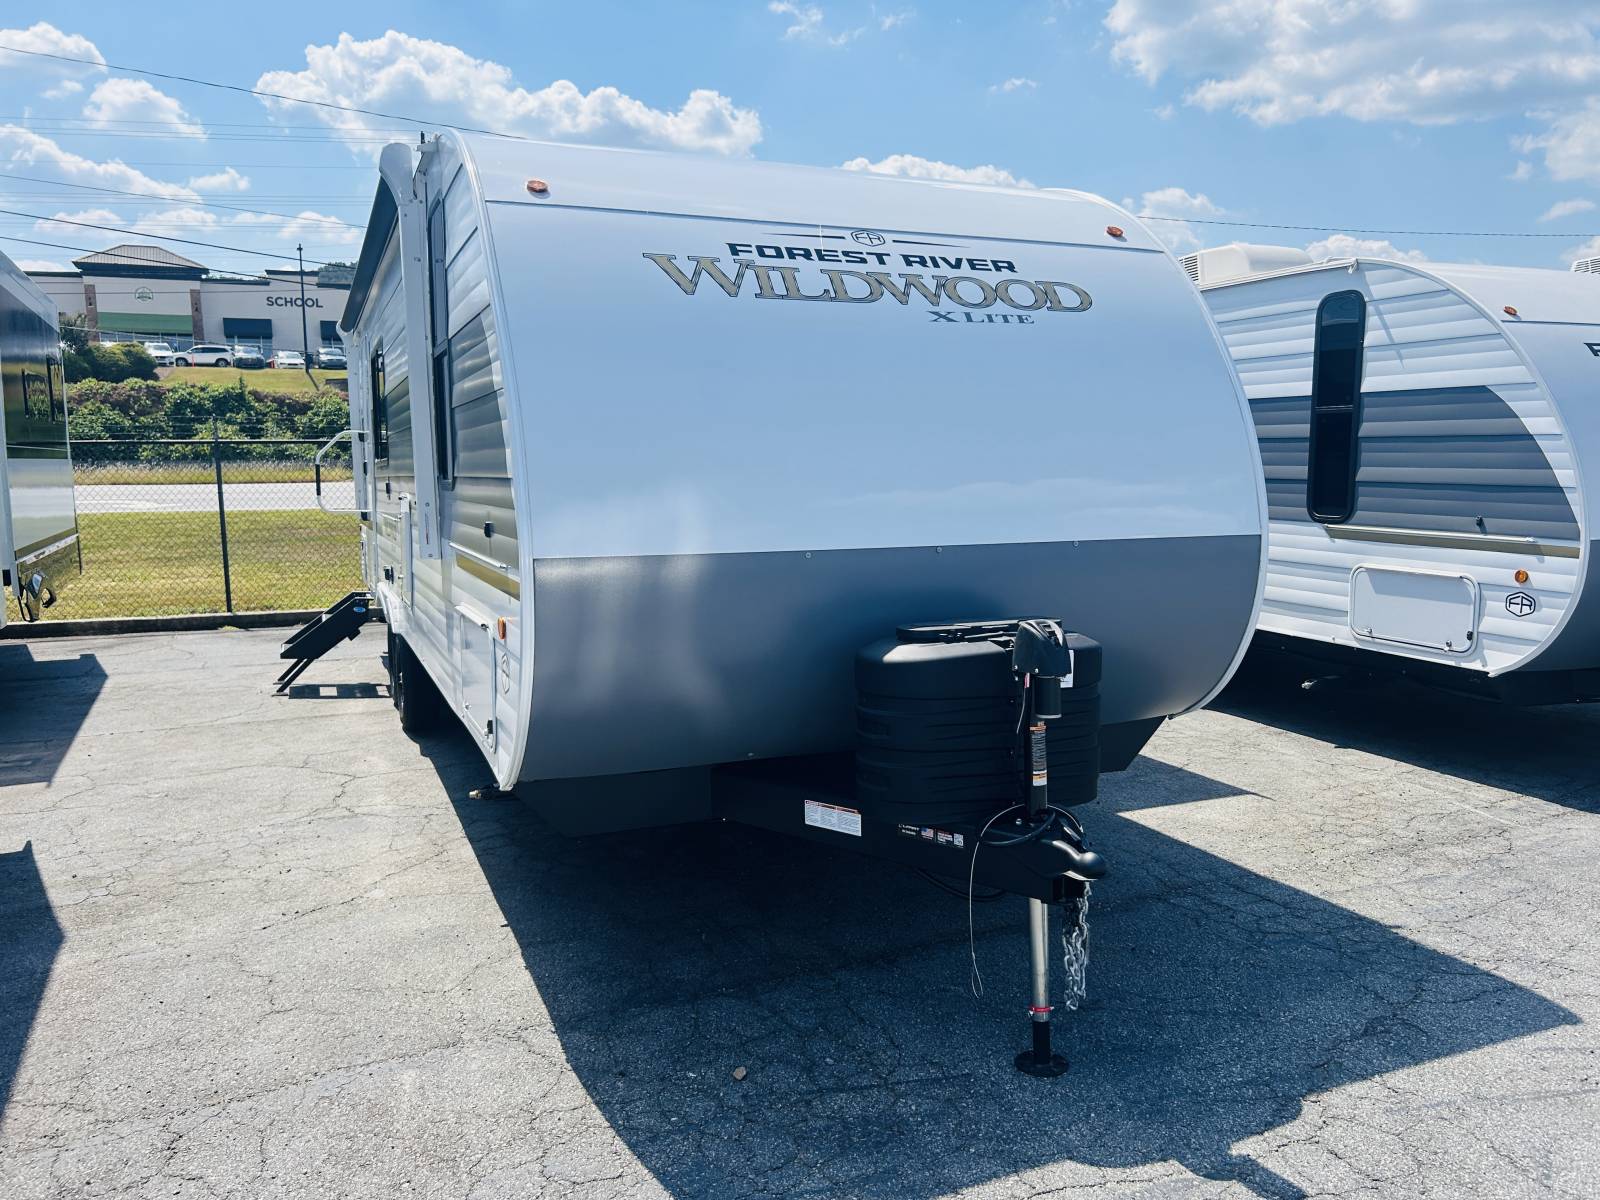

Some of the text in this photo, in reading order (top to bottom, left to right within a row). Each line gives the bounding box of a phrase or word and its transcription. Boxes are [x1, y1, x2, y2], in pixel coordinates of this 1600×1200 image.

[725, 242, 1019, 273] FOREST RIVER
[642, 252, 1093, 312] WILDWOOD
[266, 296, 324, 308] SCHOOL
[926, 310, 961, 323] X
